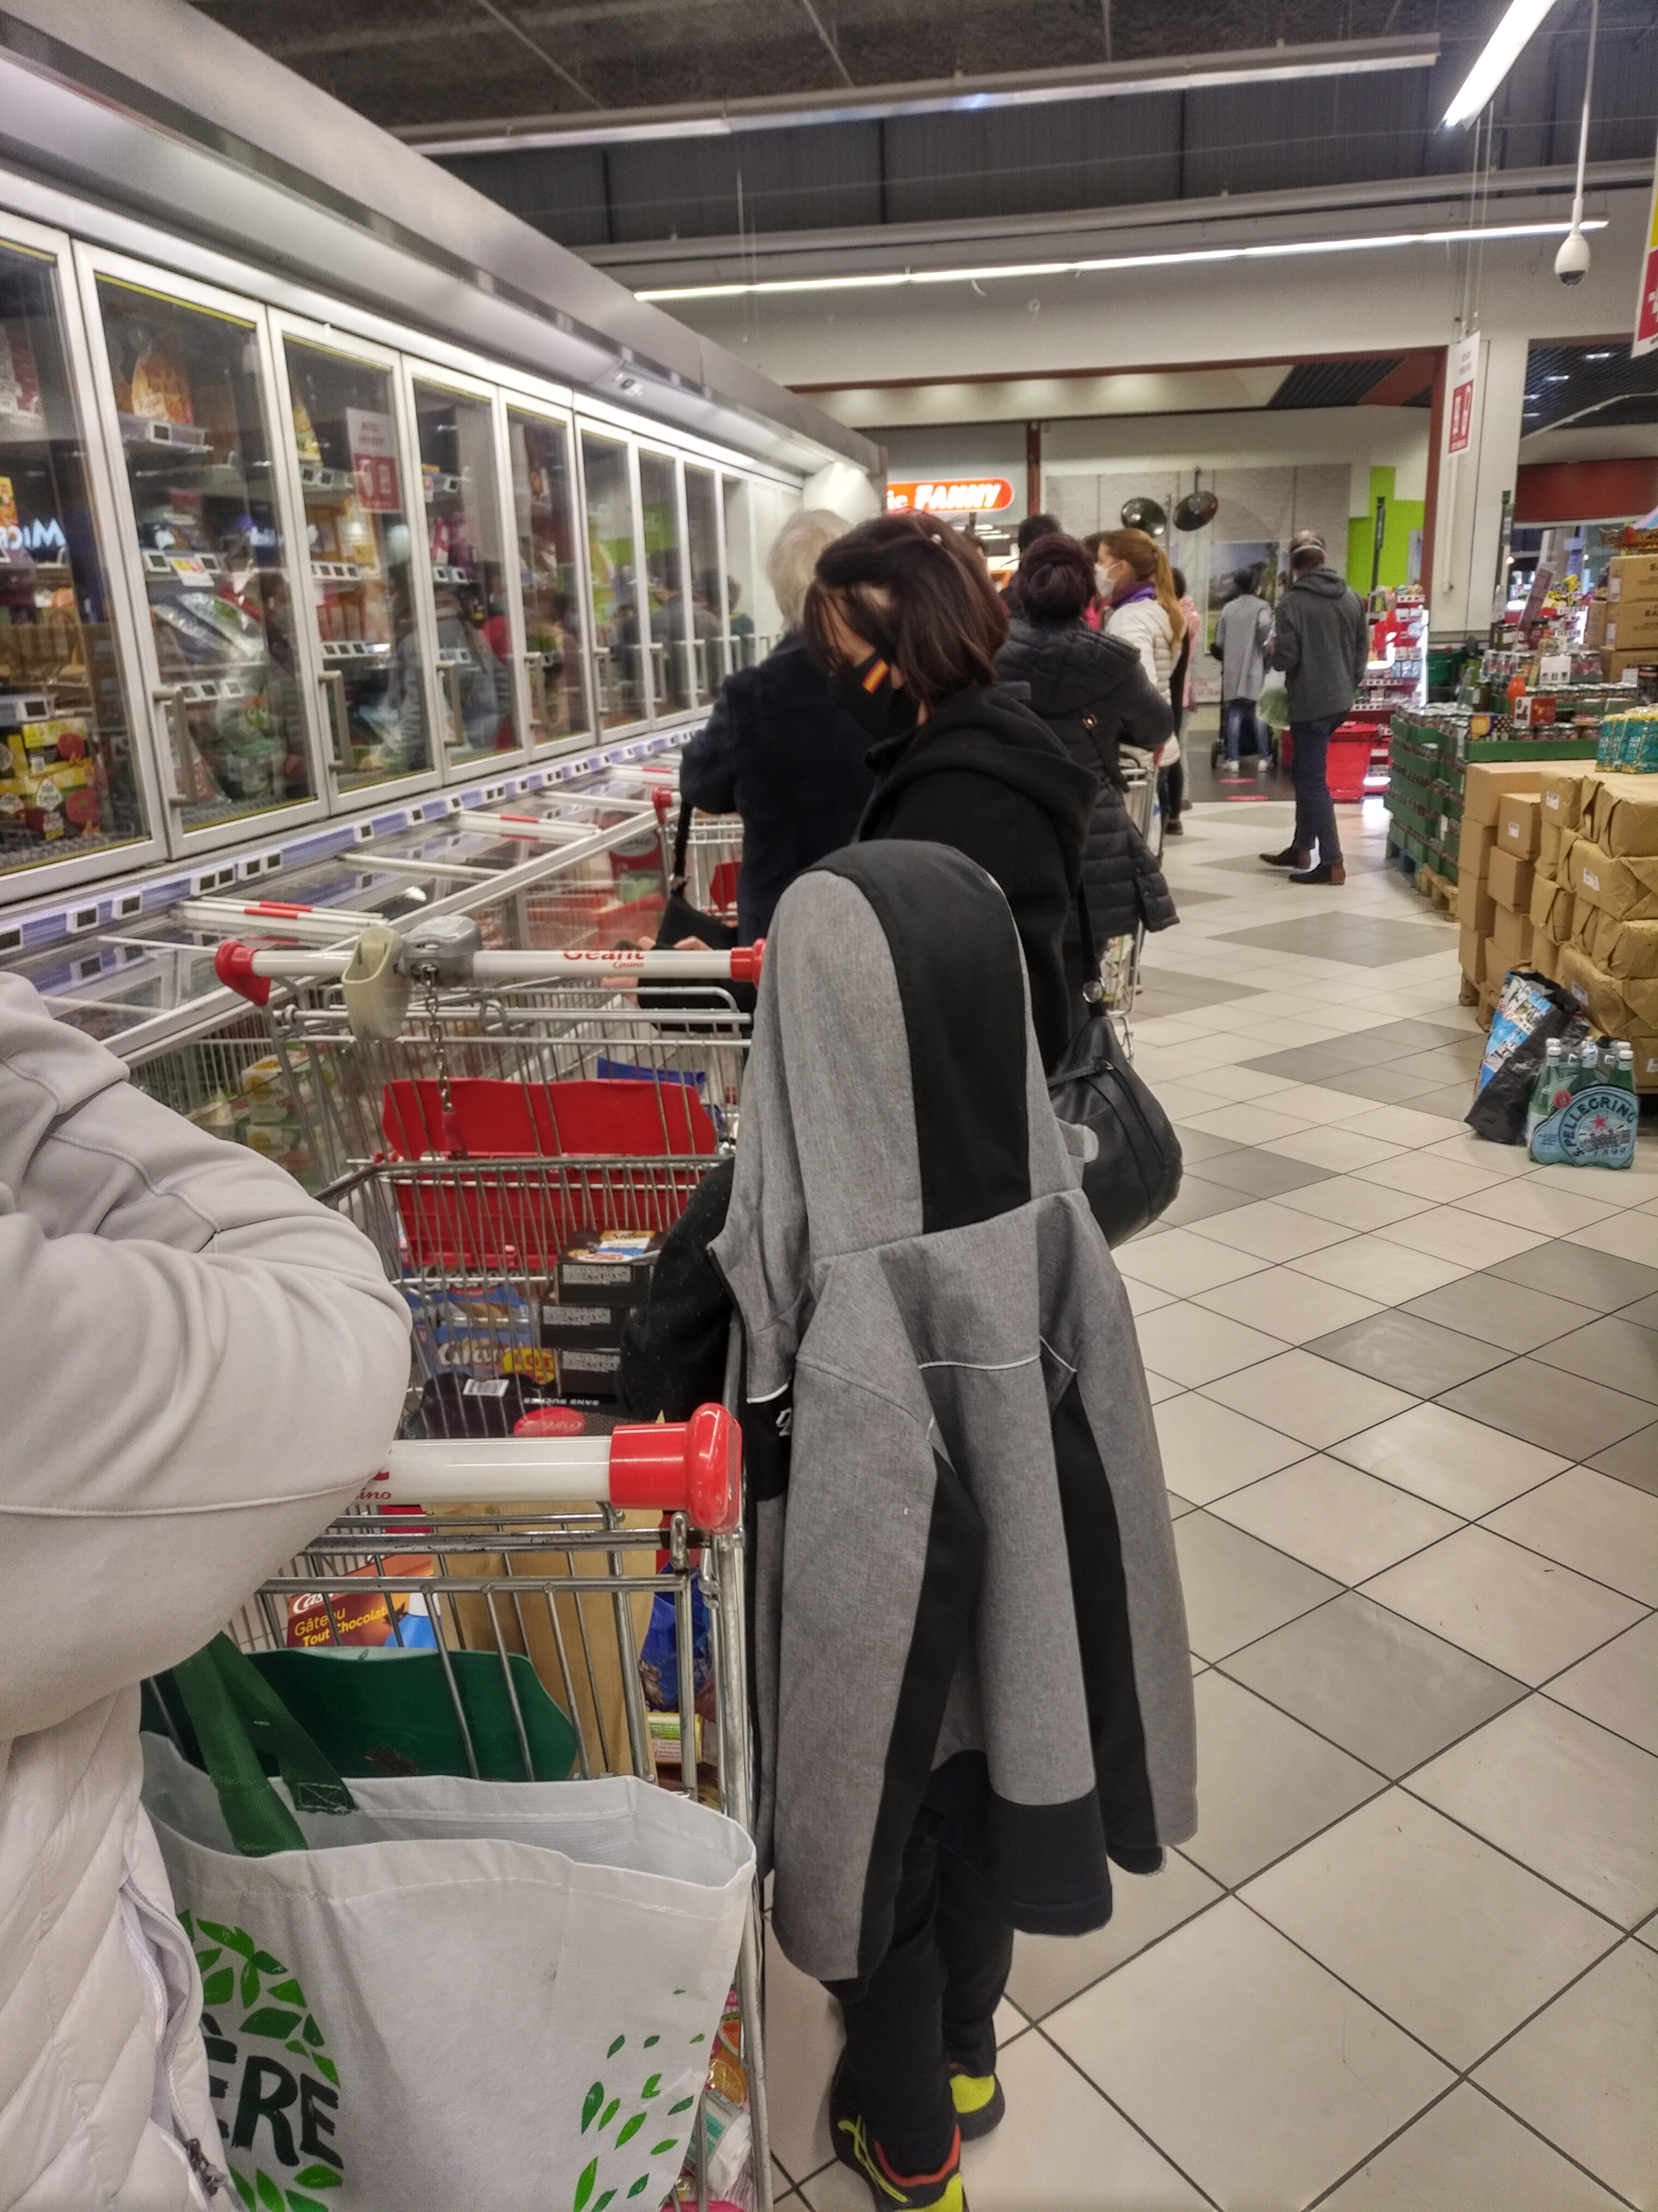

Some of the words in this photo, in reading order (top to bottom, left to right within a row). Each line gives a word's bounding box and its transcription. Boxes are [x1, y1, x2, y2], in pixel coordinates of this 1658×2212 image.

[887, 489, 908, 509] ie
[915, 484, 1001, 509] FANNY
[1563, 1096, 1636, 1147] PELLEGRINO
[1593, 1146, 1626, 1157] 1899
[302, 1628, 330, 1647] Tout
